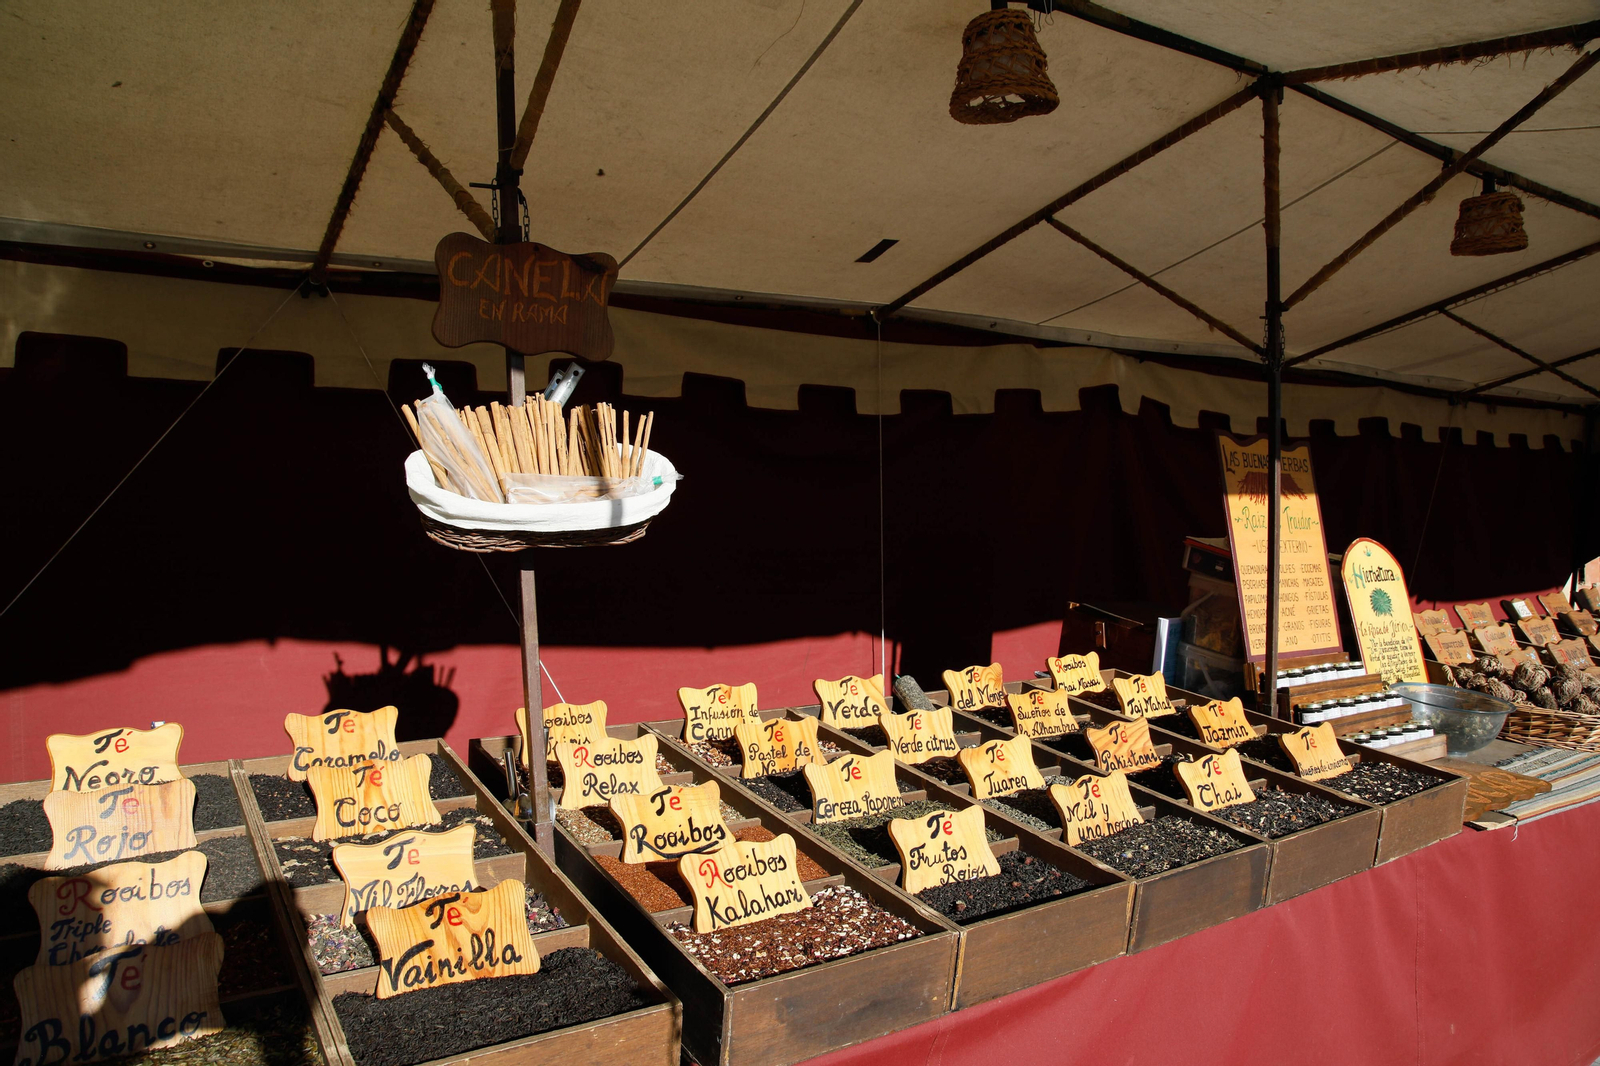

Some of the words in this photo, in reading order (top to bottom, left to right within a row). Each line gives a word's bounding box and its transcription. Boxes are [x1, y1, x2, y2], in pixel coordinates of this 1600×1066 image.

[448, 251, 609, 308] CANELA
[479, 299, 506, 321] EN
[512, 302, 569, 325] RAMA
[966, 667, 981, 684] Té
[1055, 657, 1086, 673] Rooibos
[707, 687, 730, 704] Té
[840, 676, 859, 696] Té
[1133, 677, 1147, 693] Té
[827, 695, 882, 720] Verde
[957, 689, 976, 709] del
[1029, 692, 1044, 705] Té
[1127, 697, 1144, 716] Taj
[1209, 701, 1225, 717] Té
[324, 710, 358, 734] Té
[544, 708, 593, 728] ooibos
[689, 704, 746, 724] Infusión
[748, 704, 759, 717] de
[906, 711, 922, 731] Té
[1017, 706, 1051, 720] Sueños
[1054, 703, 1066, 716] de
[764, 720, 785, 743] Té
[1031, 718, 1079, 736] Alhambra
[1109, 723, 1128, 744] Té
[1202, 720, 1249, 743] Jazmín
[93, 728, 133, 754] Té
[748, 743, 788, 761] Pastel
[794, 741, 811, 757] de
[891, 733, 924, 755] Verde
[925, 735, 956, 752] citrus
[1300, 730, 1317, 751] Té
[294, 739, 400, 771] Caramelo
[573, 743, 644, 769] Rooibos
[985, 742, 1005, 764] Té
[352, 764, 384, 788] Té
[841, 758, 862, 782] Té
[1201, 755, 1222, 778] Té
[582, 773, 641, 801] Relax
[1077, 777, 1102, 800] Té
[1197, 783, 1242, 808] Chai
[98, 786, 142, 820] Té
[334, 796, 403, 828] Coco
[650, 786, 683, 816] Té
[816, 797, 862, 819] Cereza
[1066, 798, 1097, 822] Mil
[1101, 802, 1110, 822] y
[927, 812, 954, 839] Té
[1078, 823, 1106, 842] una
[64, 824, 153, 864] Rojo
[630, 817, 726, 859] Rooibos
[383, 836, 427, 870] Té
[910, 841, 968, 870] Frutos
[699, 847, 787, 889] Rooibos
[57, 868, 192, 915] Rooibos
[349, 879, 393, 917] Mil
[426, 892, 470, 930] Té
[705, 880, 803, 930] Kalahari
[50, 913, 113, 941] Triple
[382, 927, 523, 991] Vainilla
[89, 945, 148, 1002] Té
[18, 1010, 208, 1066] Blanco
